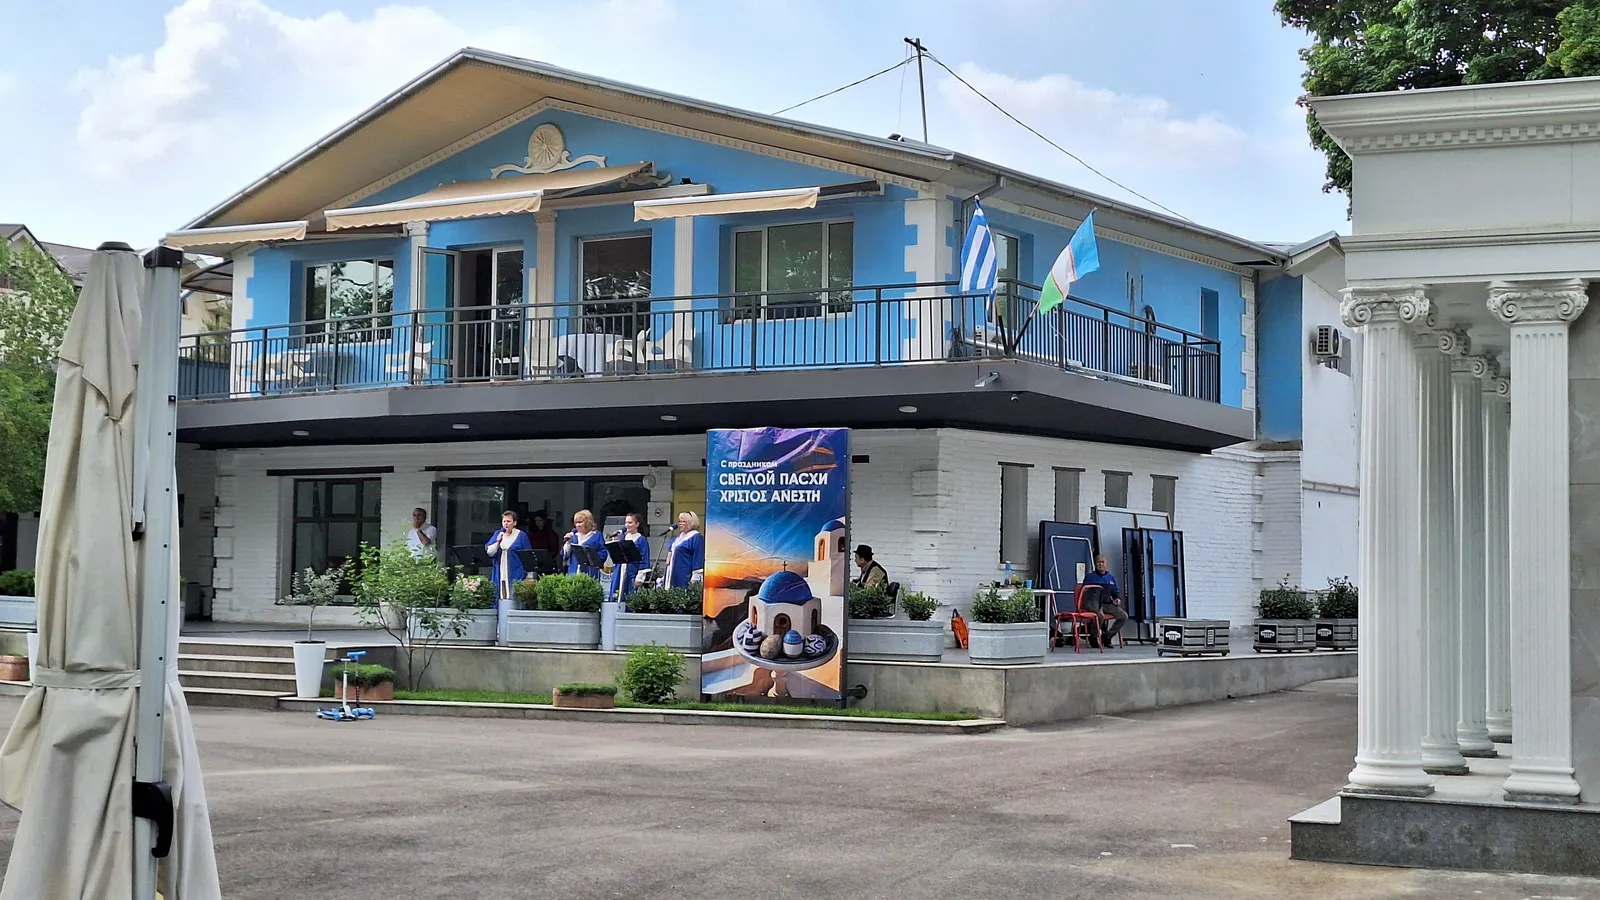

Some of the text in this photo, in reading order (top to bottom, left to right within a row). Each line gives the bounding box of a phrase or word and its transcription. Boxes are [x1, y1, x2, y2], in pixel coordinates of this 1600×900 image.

[720, 460, 778, 469] С праздником
[719, 470, 828, 485] СВЕТЛОЙ ПАСХИ
[719, 490, 821, 503] ΧΡΙΣΤΟΣ ΑΝΕΣΤΗ
